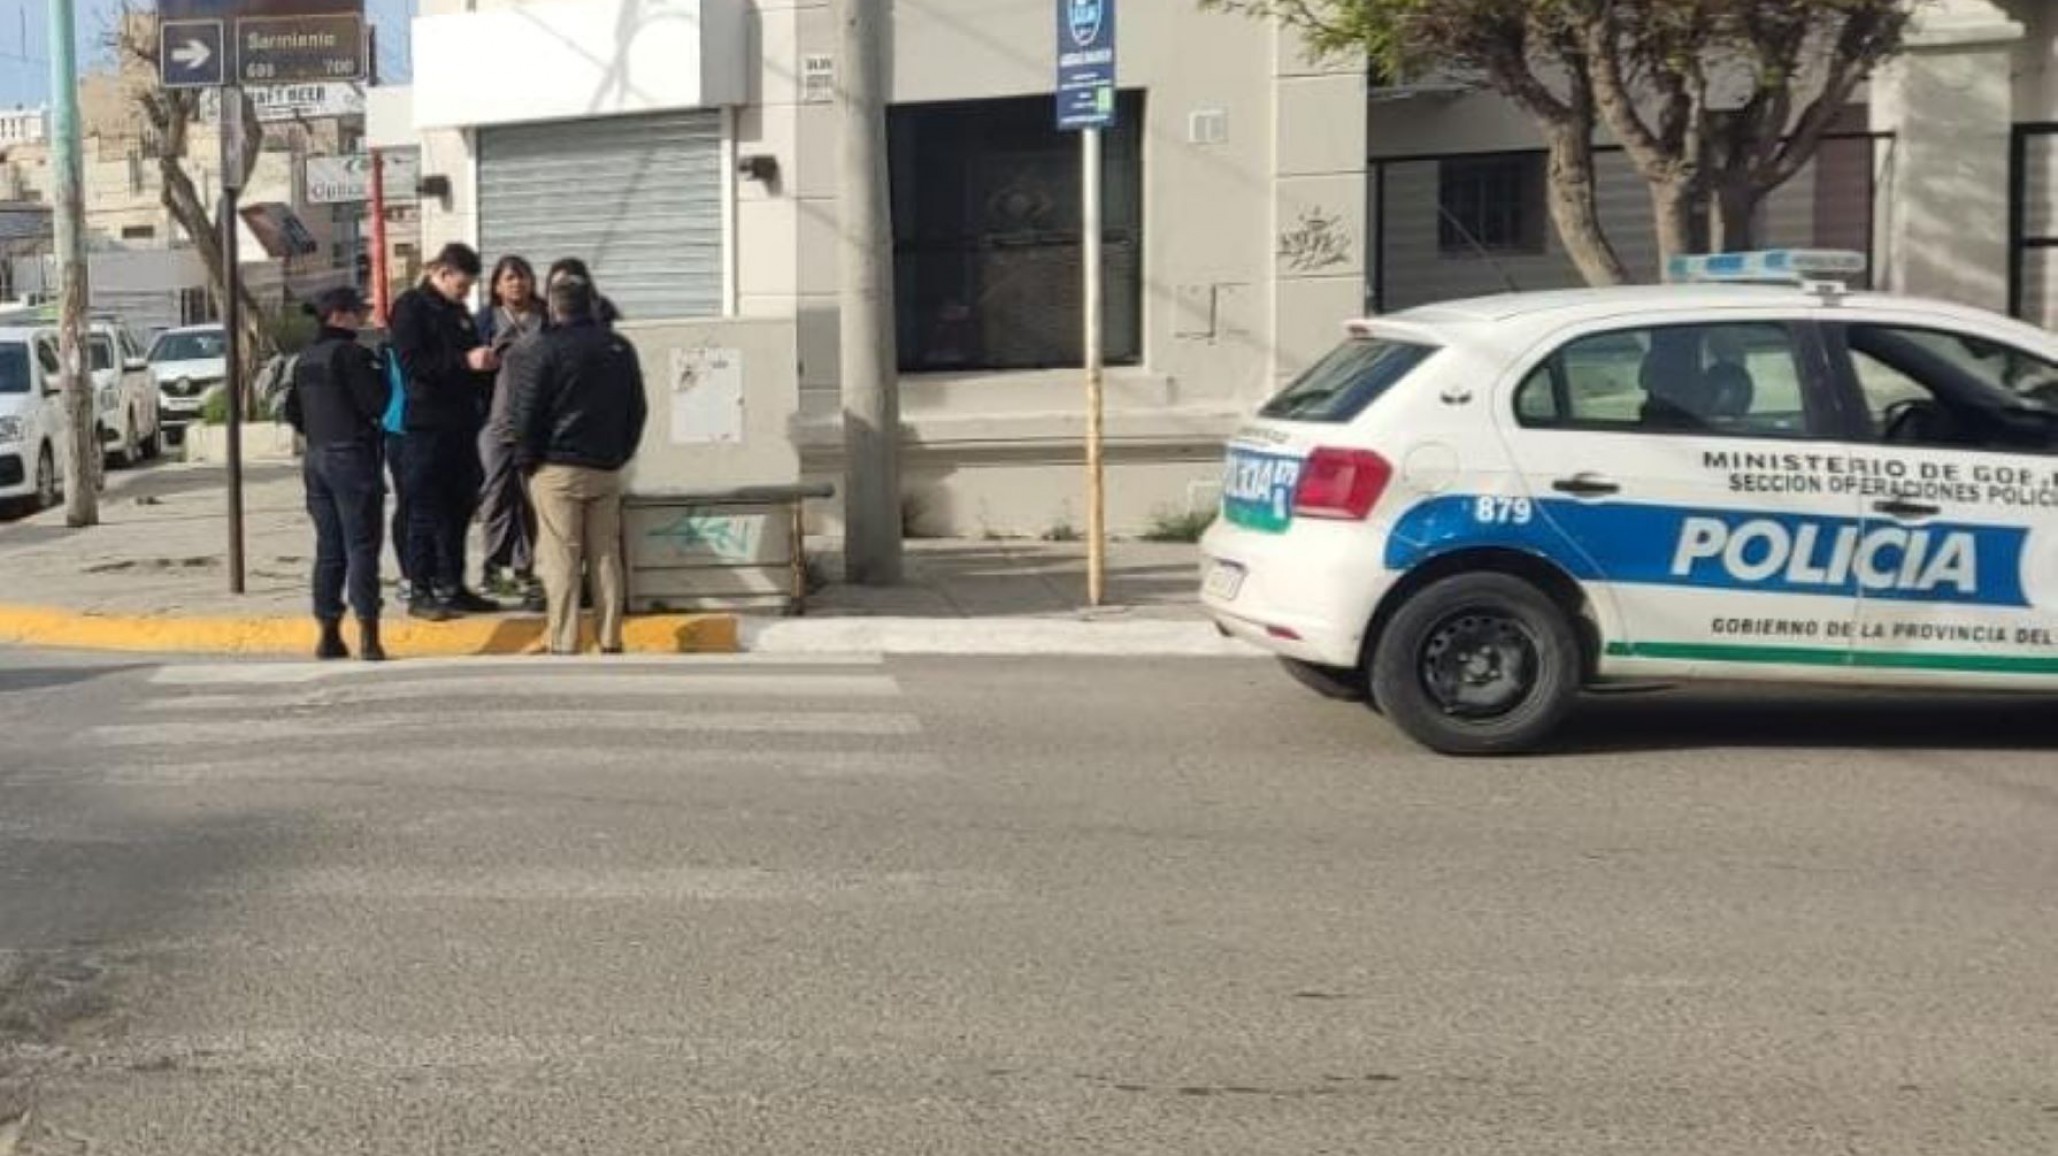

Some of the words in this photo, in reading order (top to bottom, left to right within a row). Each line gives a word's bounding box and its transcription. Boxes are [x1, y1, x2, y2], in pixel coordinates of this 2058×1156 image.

[1702, 451, 1908, 478] MINISTERIO
[1920, 462, 1960, 482] DE
[1728, 473, 1822, 493] SECCION
[1829, 475, 1980, 502] OPERACIONES
[1473, 496, 1533, 524] 879
[1670, 516, 1978, 593] POLICIA
[1712, 617, 1818, 636] GOBIERNO
[1827, 621, 1854, 638] DE
[1862, 623, 1884, 638] LA
[1893, 623, 2006, 643] PROVINCIA
[2015, 627, 2051, 645] DEL
